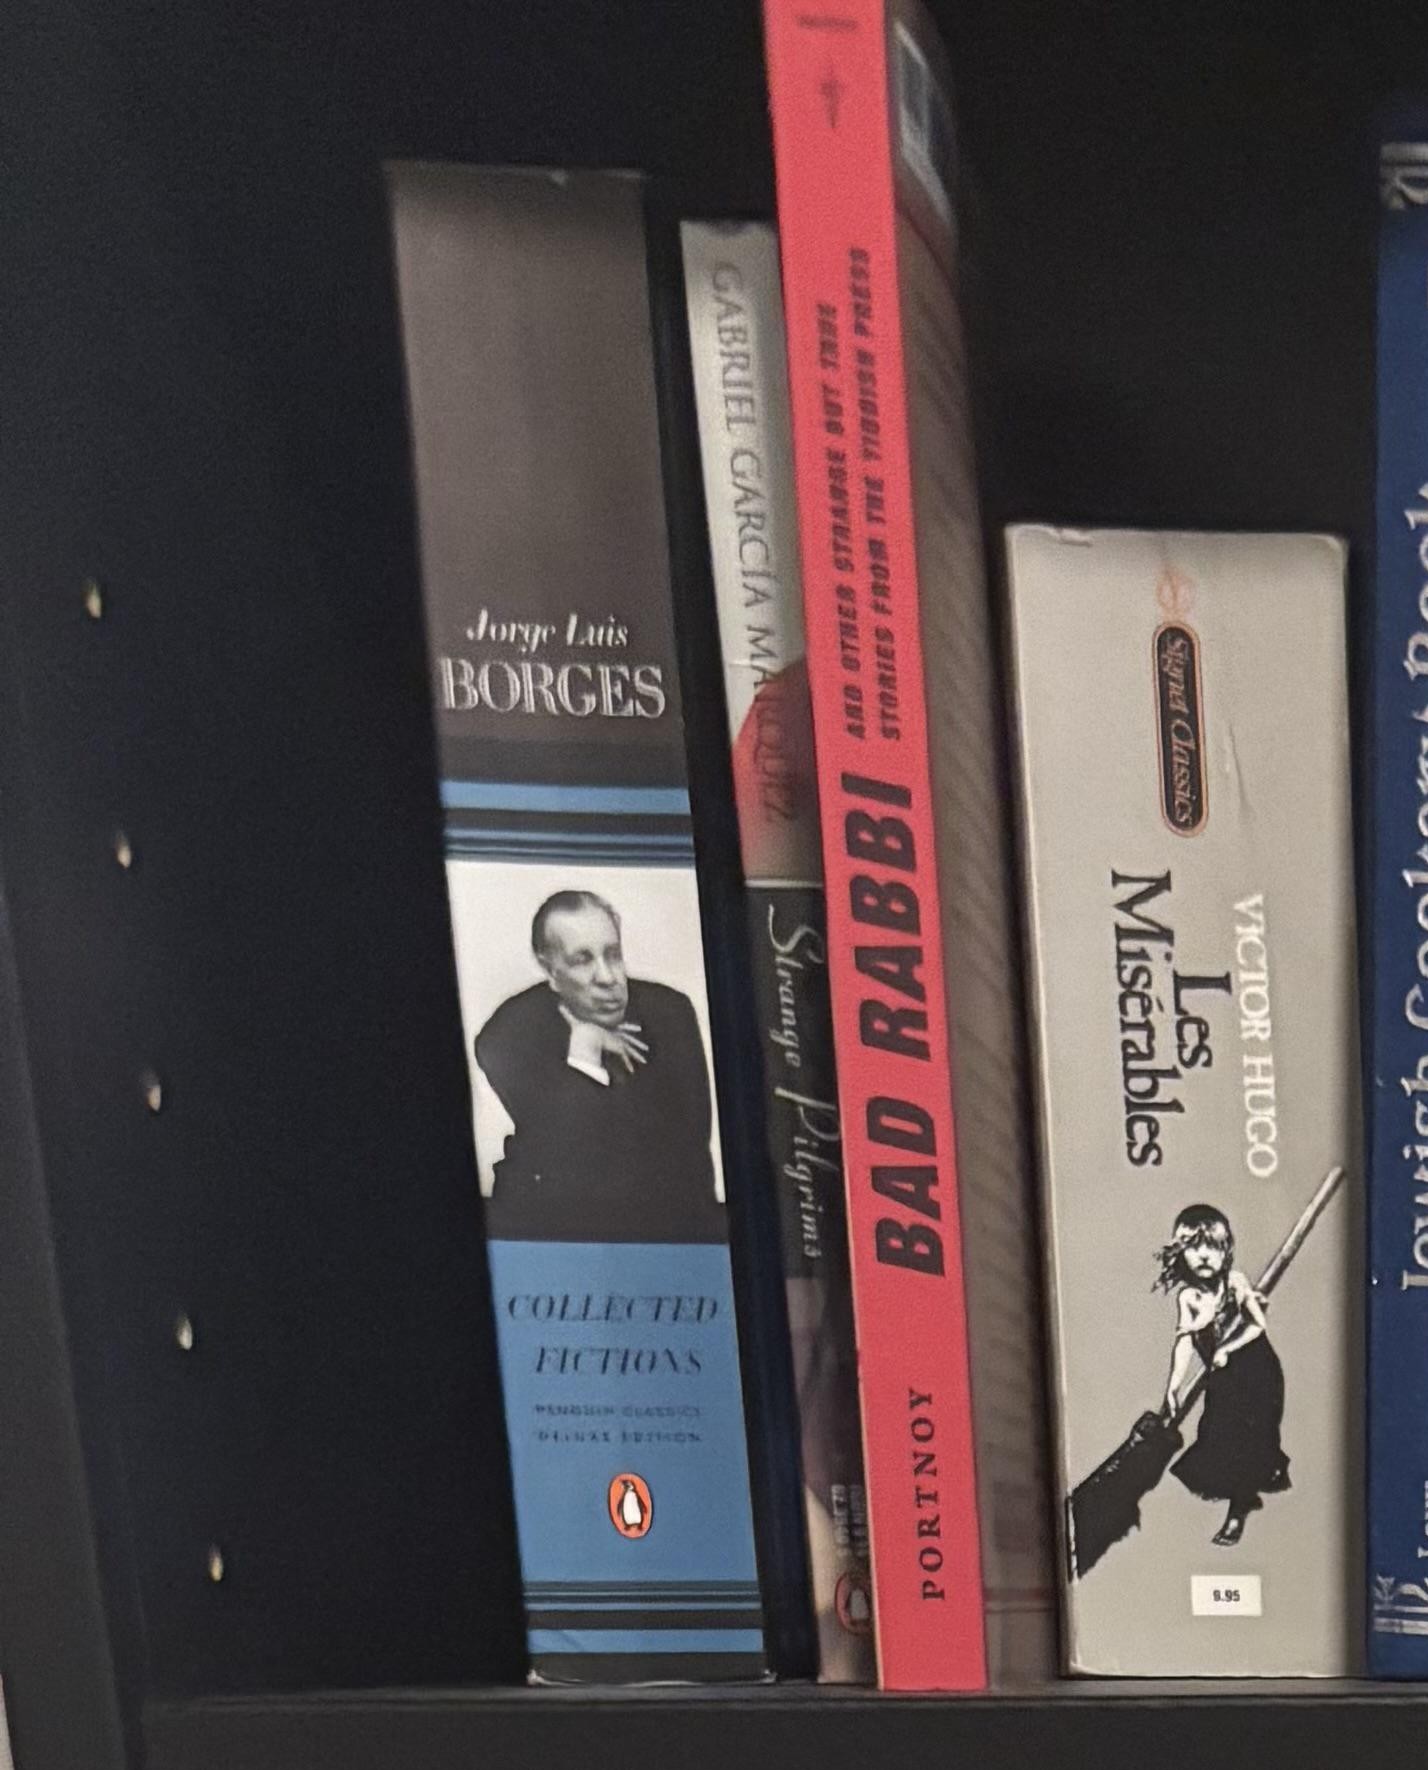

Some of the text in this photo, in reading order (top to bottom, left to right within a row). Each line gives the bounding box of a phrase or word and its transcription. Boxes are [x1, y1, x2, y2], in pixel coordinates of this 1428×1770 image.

[441, 660, 666, 719] BORGES
[840, 772, 945, 1278] BAD RABBI
[1109, 867, 1184, 1167] Misérables
[1236, 894, 1277, 1177] VICTOR HUGO
[916, 1388, 945, 1601] PORTNOY
